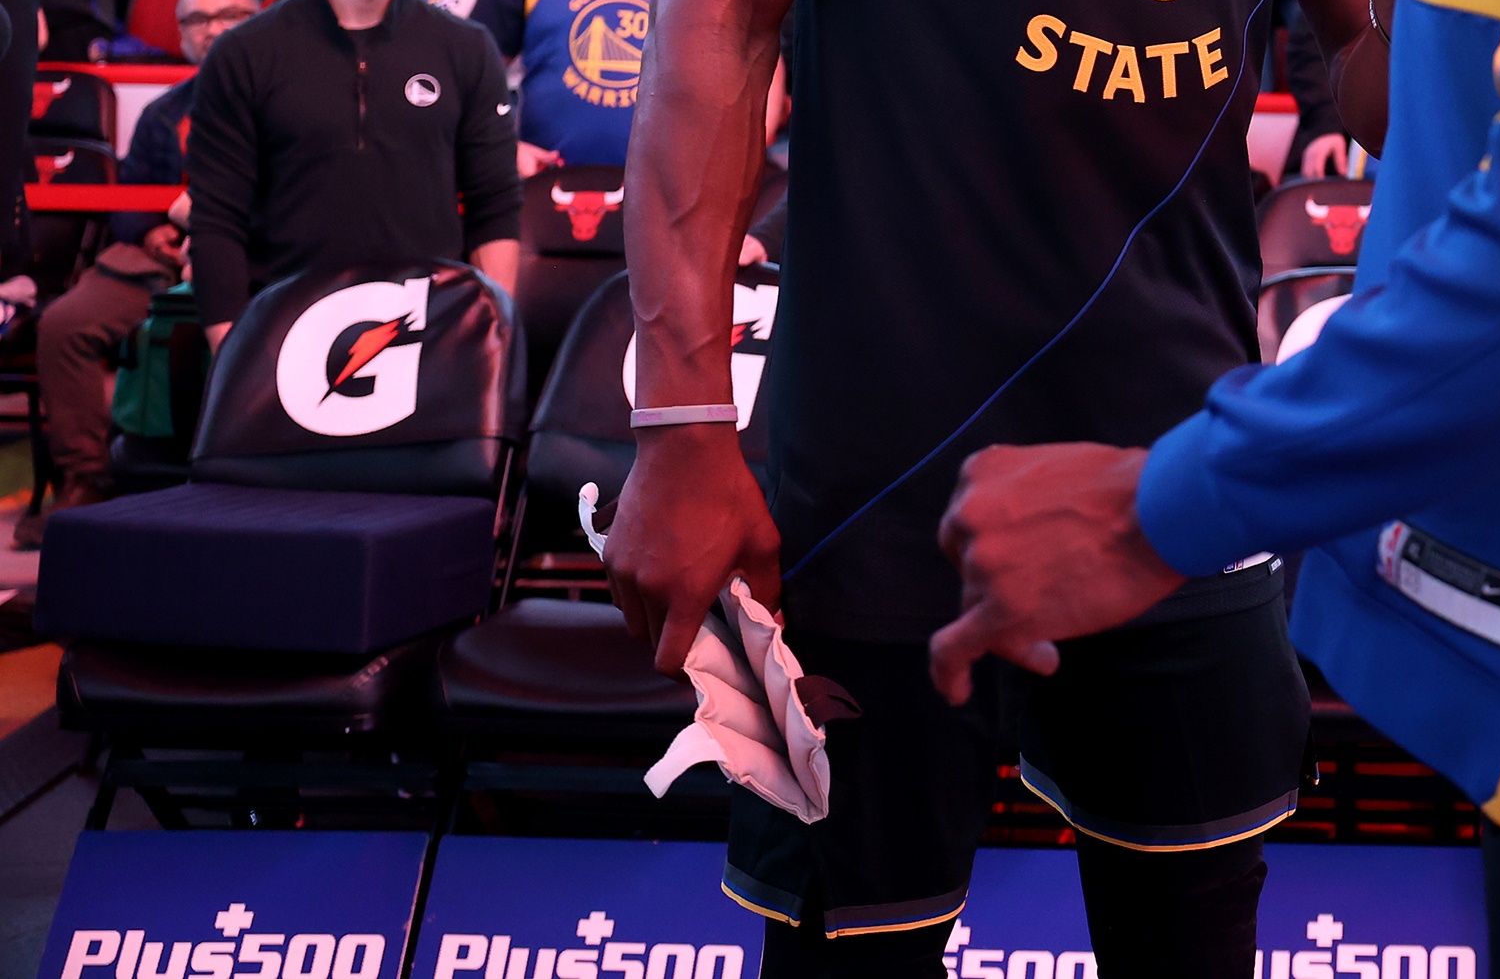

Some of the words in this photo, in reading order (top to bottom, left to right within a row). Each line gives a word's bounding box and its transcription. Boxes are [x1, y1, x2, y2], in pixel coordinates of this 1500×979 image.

[615, 9, 649, 40] 30
[1015, 14, 1229, 103] STATE
[276, 277, 432, 436] G
[61, 929, 387, 979] Plus500
[434, 933, 745, 979] Plus500
